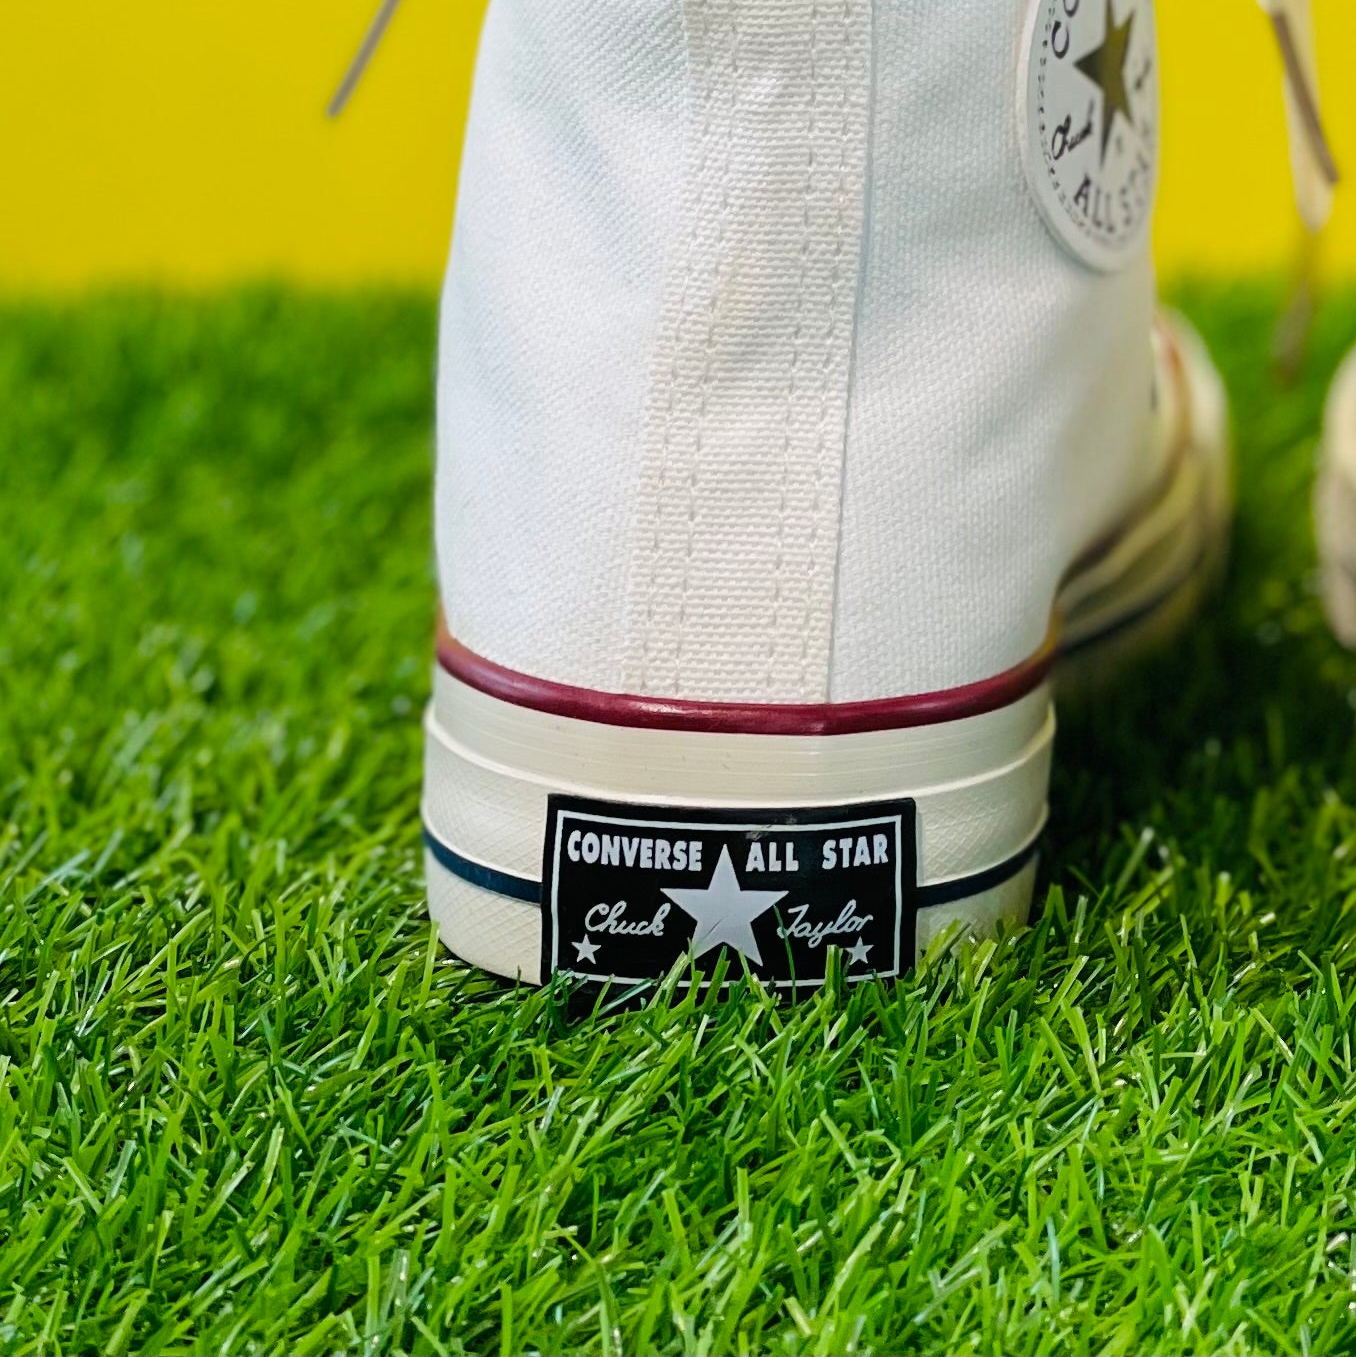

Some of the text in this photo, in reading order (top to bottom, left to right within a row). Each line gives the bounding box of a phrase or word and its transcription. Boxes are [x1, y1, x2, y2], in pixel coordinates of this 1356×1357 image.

[1073, 173, 1117, 235] ALL
[567, 829, 889, 872] CONVERSE ALL STAR
[585, 899, 874, 948] Chuck Taylor
